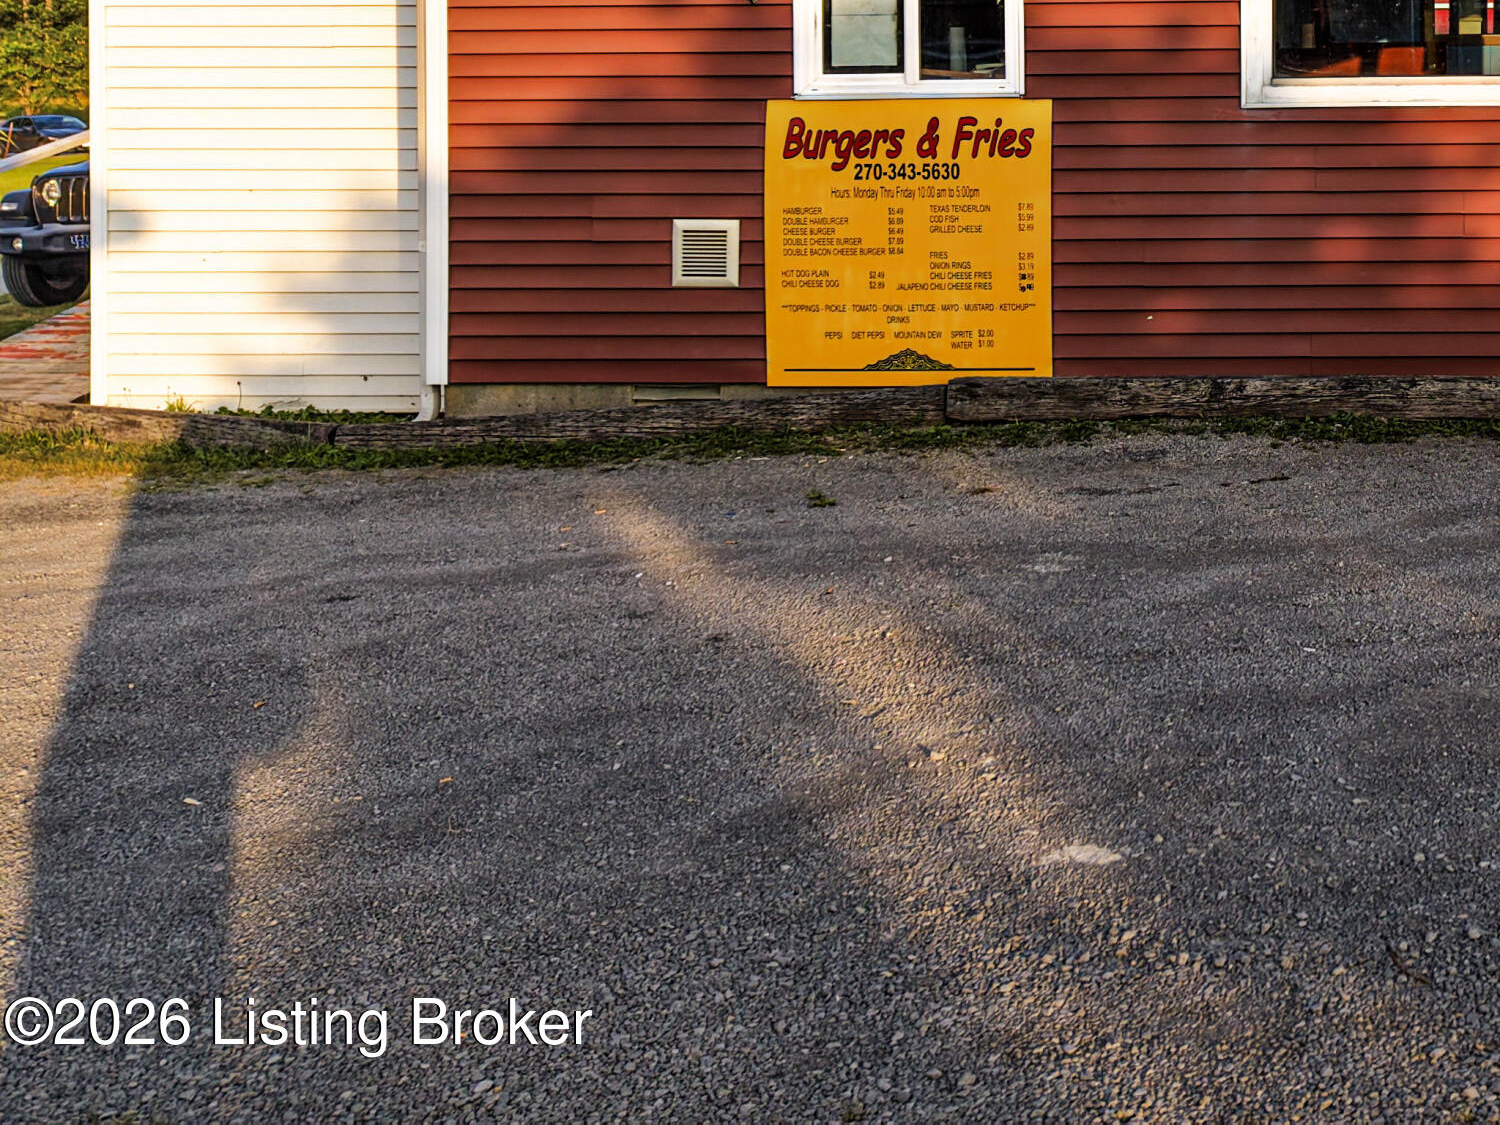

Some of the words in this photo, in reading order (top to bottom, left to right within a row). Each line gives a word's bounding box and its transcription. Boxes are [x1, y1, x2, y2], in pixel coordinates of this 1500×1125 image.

[782, 116, 906, 172] Burgers
[916, 116, 940, 160] &
[951, 116, 1035, 160] Fries
[853, 163, 960, 180] 270-343-5630
[853, 187, 878, 201] Monday
[880, 186, 895, 198] Thru
[896, 186, 915, 200] Friday
[918, 186, 936, 198] 10:00
[937, 187, 947, 198] am
[948, 186, 955, 198] to
[783, 207, 822, 215] HAMBURGER
[930, 205, 949, 213] TEXAS
[952, 205, 991, 213] TENDERLOIN
[783, 217, 808, 225] DOUBLE
[810, 217, 849, 225] HAMBURGER
[930, 215, 943, 223] COD
[945, 215, 959, 223] FISH
[930, 225, 955, 233] GRILLED
[958, 225, 982, 233] CHEESE
[783, 238, 808, 246] DOUBLE
[810, 238, 834, 246] CHEESE
[836, 238, 862, 246] BURGER
[783, 248, 808, 256] DOUBLE
[810, 248, 831, 256] BACON
[833, 248, 857, 256] CHEESE
[860, 248, 886, 256] BURGER
[930, 262, 950, 270] ONION
[952, 262, 971, 270] RINGS
[930, 272, 946, 280] CHILI
[947, 272, 972, 280] CHEESE
[974, 272, 992, 280] FRIES
[781, 280, 797, 288] CHILI
[799, 280, 823, 288] CHEESE
[825, 280, 839, 288] DOG
[897, 283, 928, 291] JALAPENO
[930, 283, 946, 291] CHILI
[947, 283, 972, 291] CHEESE
[974, 283, 992, 291] FRIES
[825, 304, 847, 312] PICKLE
[852, 304, 877, 312] TOMATO
[883, 304, 902, 312] ONION
[908, 303, 935, 312] LETTUCE
[941, 303, 959, 312] MAYO
[964, 303, 994, 312] MUSTARD
[887, 316, 910, 324] DRINKS
[825, 331, 843, 339] PEPSI
[852, 331, 865, 339] DIET
[867, 331, 885, 339] PEPSI
[894, 331, 926, 339] MOUNTAIN
[928, 331, 942, 339] DEW
[951, 331, 973, 339] SPRITE
[978, 329, 994, 337] $2.00
[951, 341, 973, 349] WATER
[978, 339, 994, 348] $1.00
